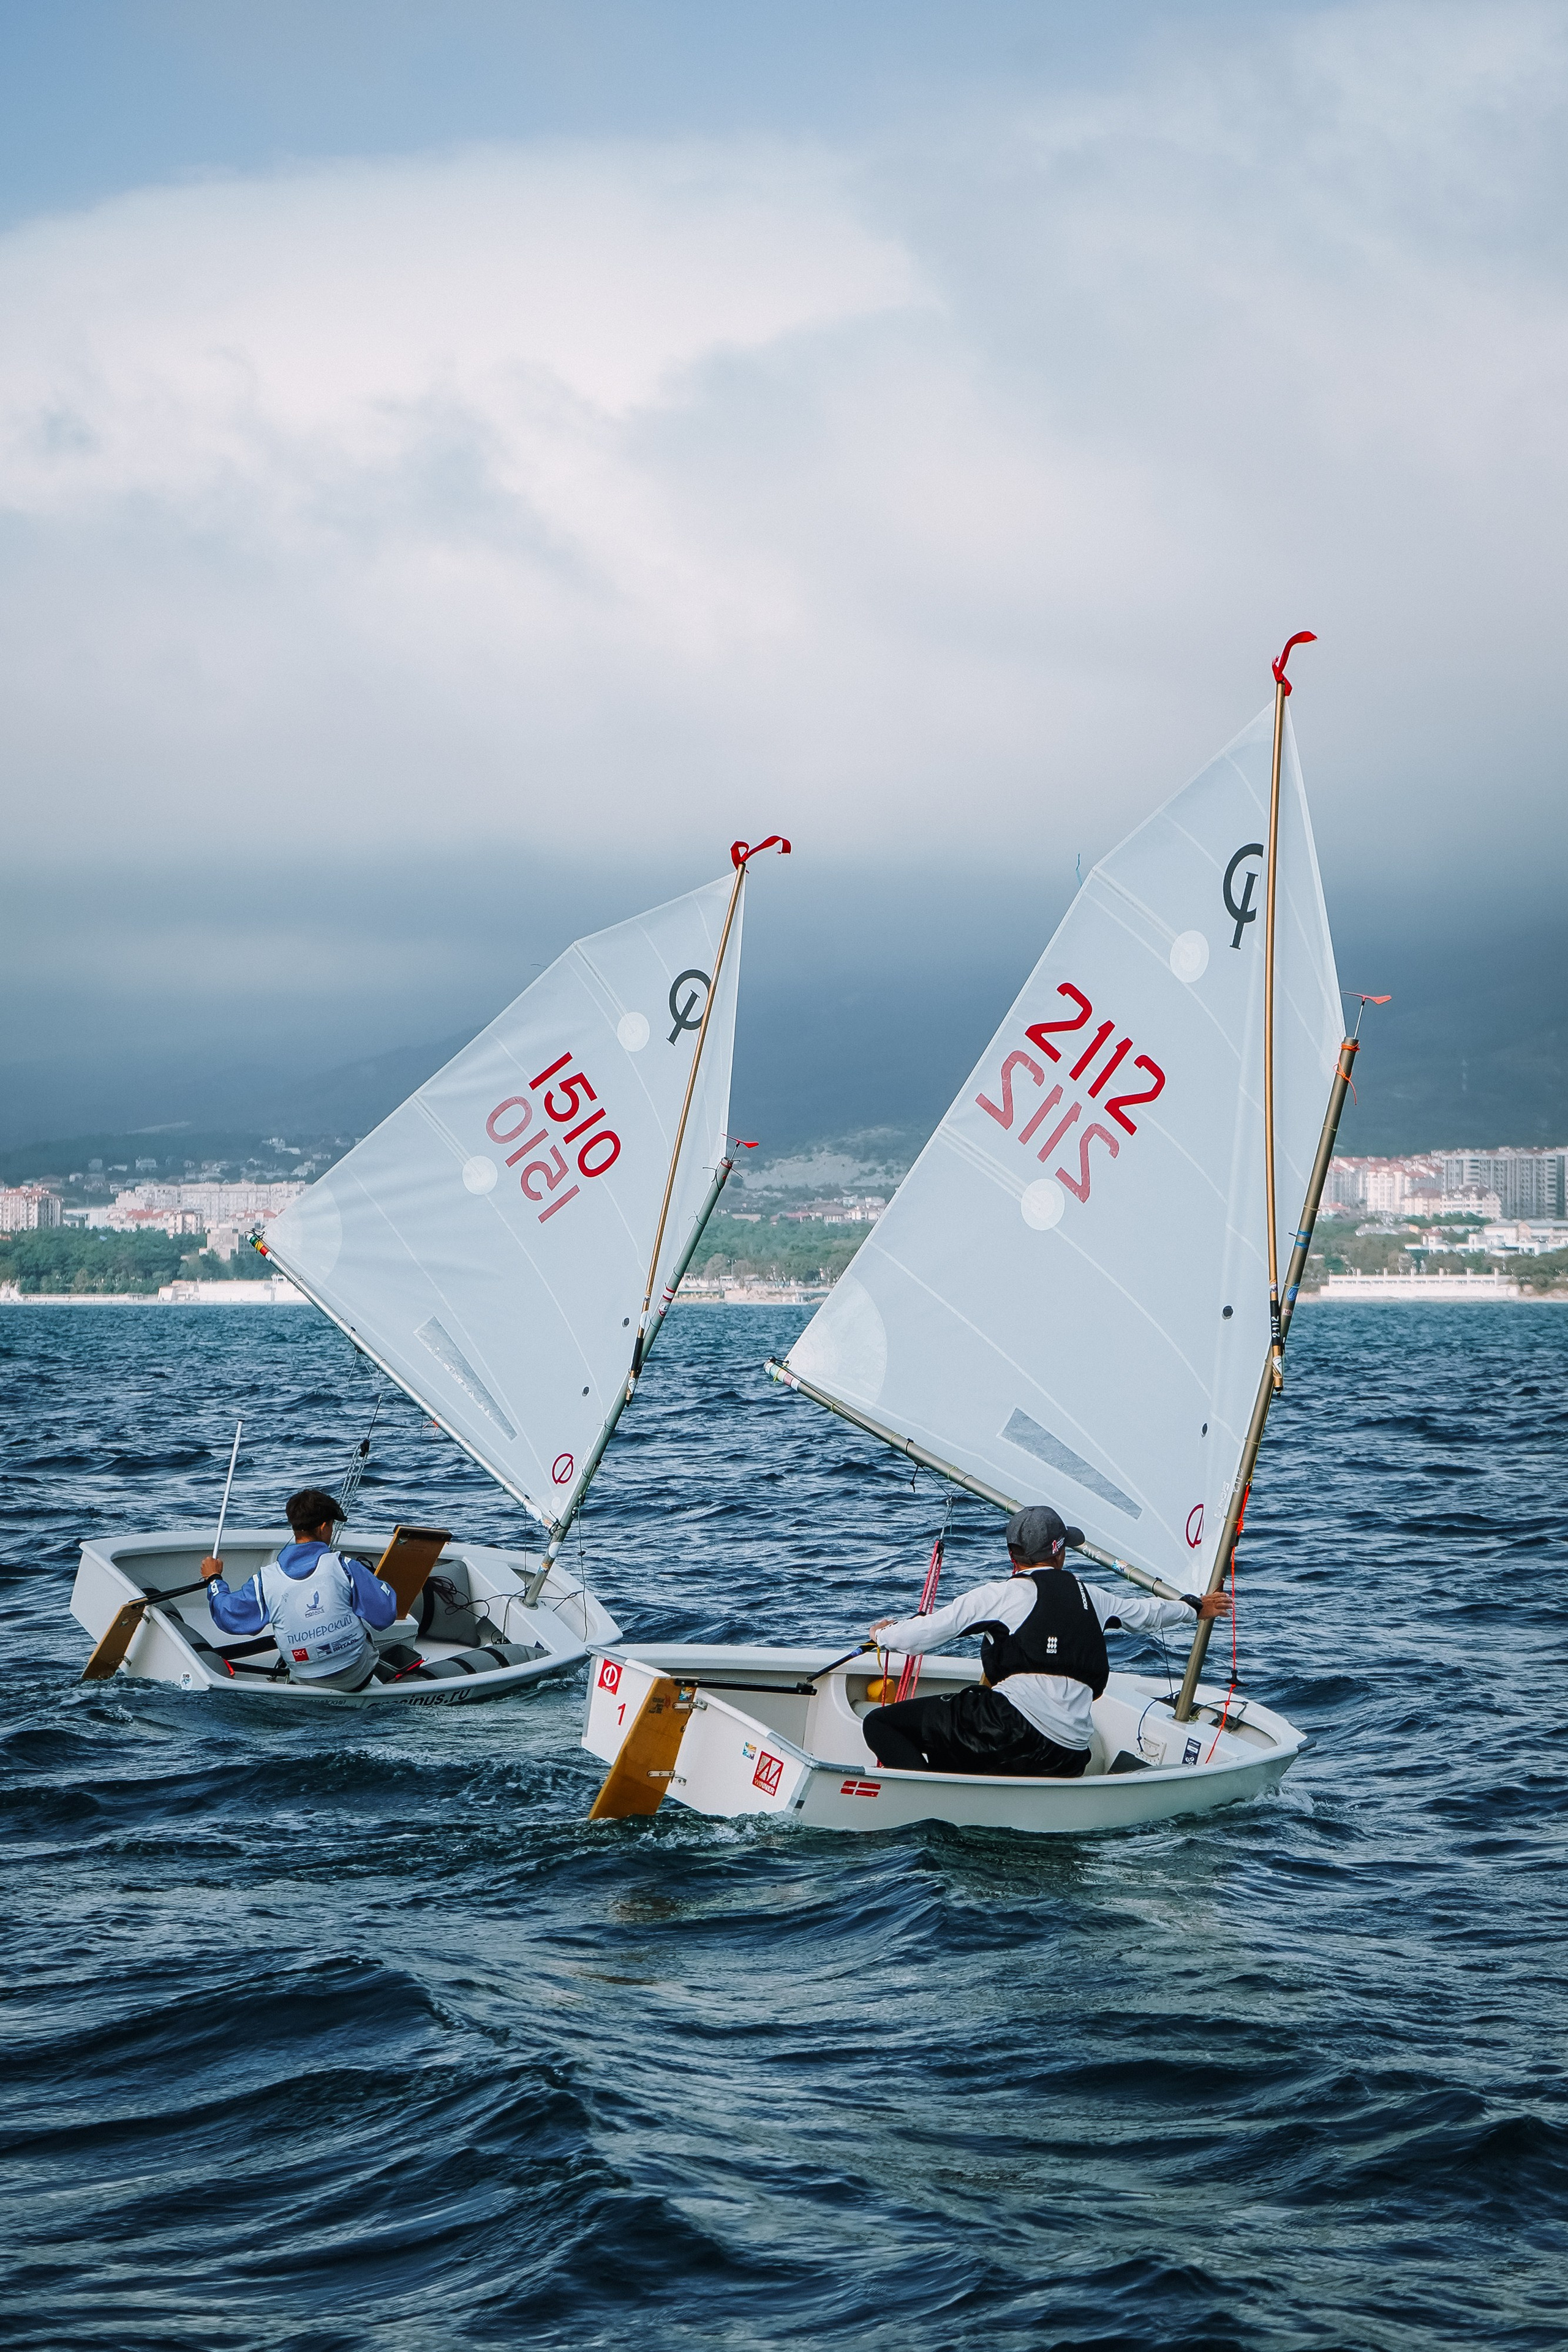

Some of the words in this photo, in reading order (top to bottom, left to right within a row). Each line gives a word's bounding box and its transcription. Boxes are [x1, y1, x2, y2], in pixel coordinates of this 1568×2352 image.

[1024, 982, 1166, 1136] 2112
[528, 1051, 621, 1178] 1510
[1271, 1316, 1280, 1338] 2112
[1082, 1544, 1101, 1560] 2112
[287, 1614, 352, 1645] ПИОНЕРСКИЙ
[617, 1703, 626, 1726] 1
[754, 1777, 775, 1795] WINNER
